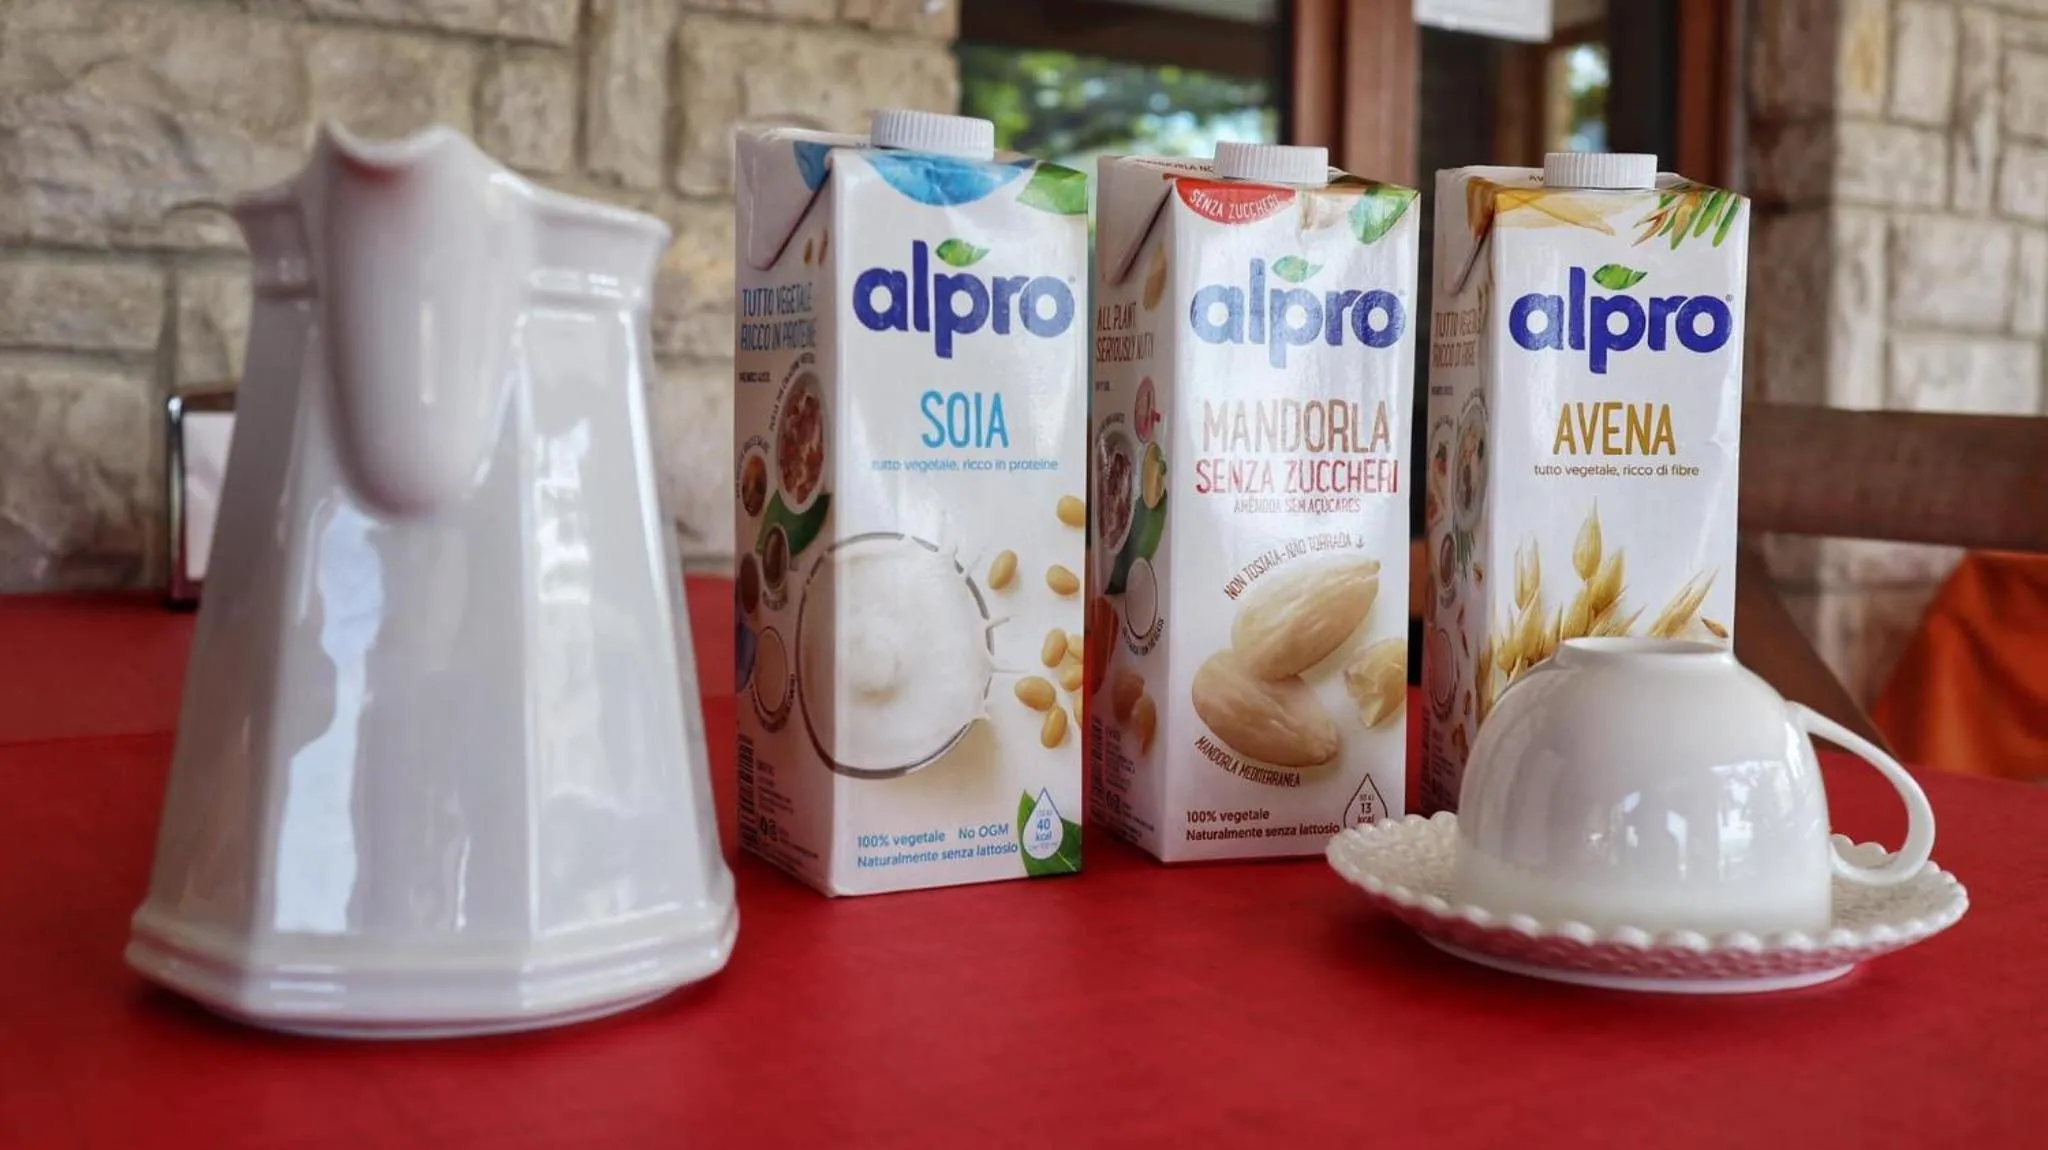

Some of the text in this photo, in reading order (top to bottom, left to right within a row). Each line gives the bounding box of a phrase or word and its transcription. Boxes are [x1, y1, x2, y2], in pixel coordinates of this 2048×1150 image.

[1189, 188, 1280, 220] SENZA ZUCCHERI
[742, 287, 774, 318] TUTTO
[852, 240, 1076, 359] alpro
[1190, 258, 1406, 368] alpro
[1097, 301, 1137, 331] ALL PLANT
[1509, 266, 1733, 374] alpro
[740, 323, 771, 352] RICCO
[1096, 334, 1137, 363] SERIOUSLY
[920, 389, 1009, 449] SOIA
[1203, 398, 1391, 453] MANDORLA
[1553, 402, 1677, 456] AVENA
[872, 459, 900, 471] tutto
[962, 459, 993, 471] ricco
[995, 459, 1006, 471] in
[1009, 459, 1059, 474] proteine
[1196, 458, 1399, 493] SENZA ZUCCHERI
[1534, 464, 1562, 476] tutto
[1622, 463, 1653, 476] ricco
[1656, 463, 1668, 476] di
[1671, 463, 1699, 476] fibre
[1223, 573, 1248, 600] NON
[1194, 735, 1301, 788] MANDORLA MEDITERRANEA
[1187, 808, 1270, 825] 100% vegetale
[1360, 802, 1372, 814] 13
[857, 823, 1009, 848] 100% vegetale No OGM
[1036, 818, 1051, 830] 40
[1186, 822, 1340, 841] Naturalmente senza lattosio
[857, 850, 939, 868] Naturalmente
[941, 849, 974, 860] senza
[976, 843, 1018, 856] lattosio
